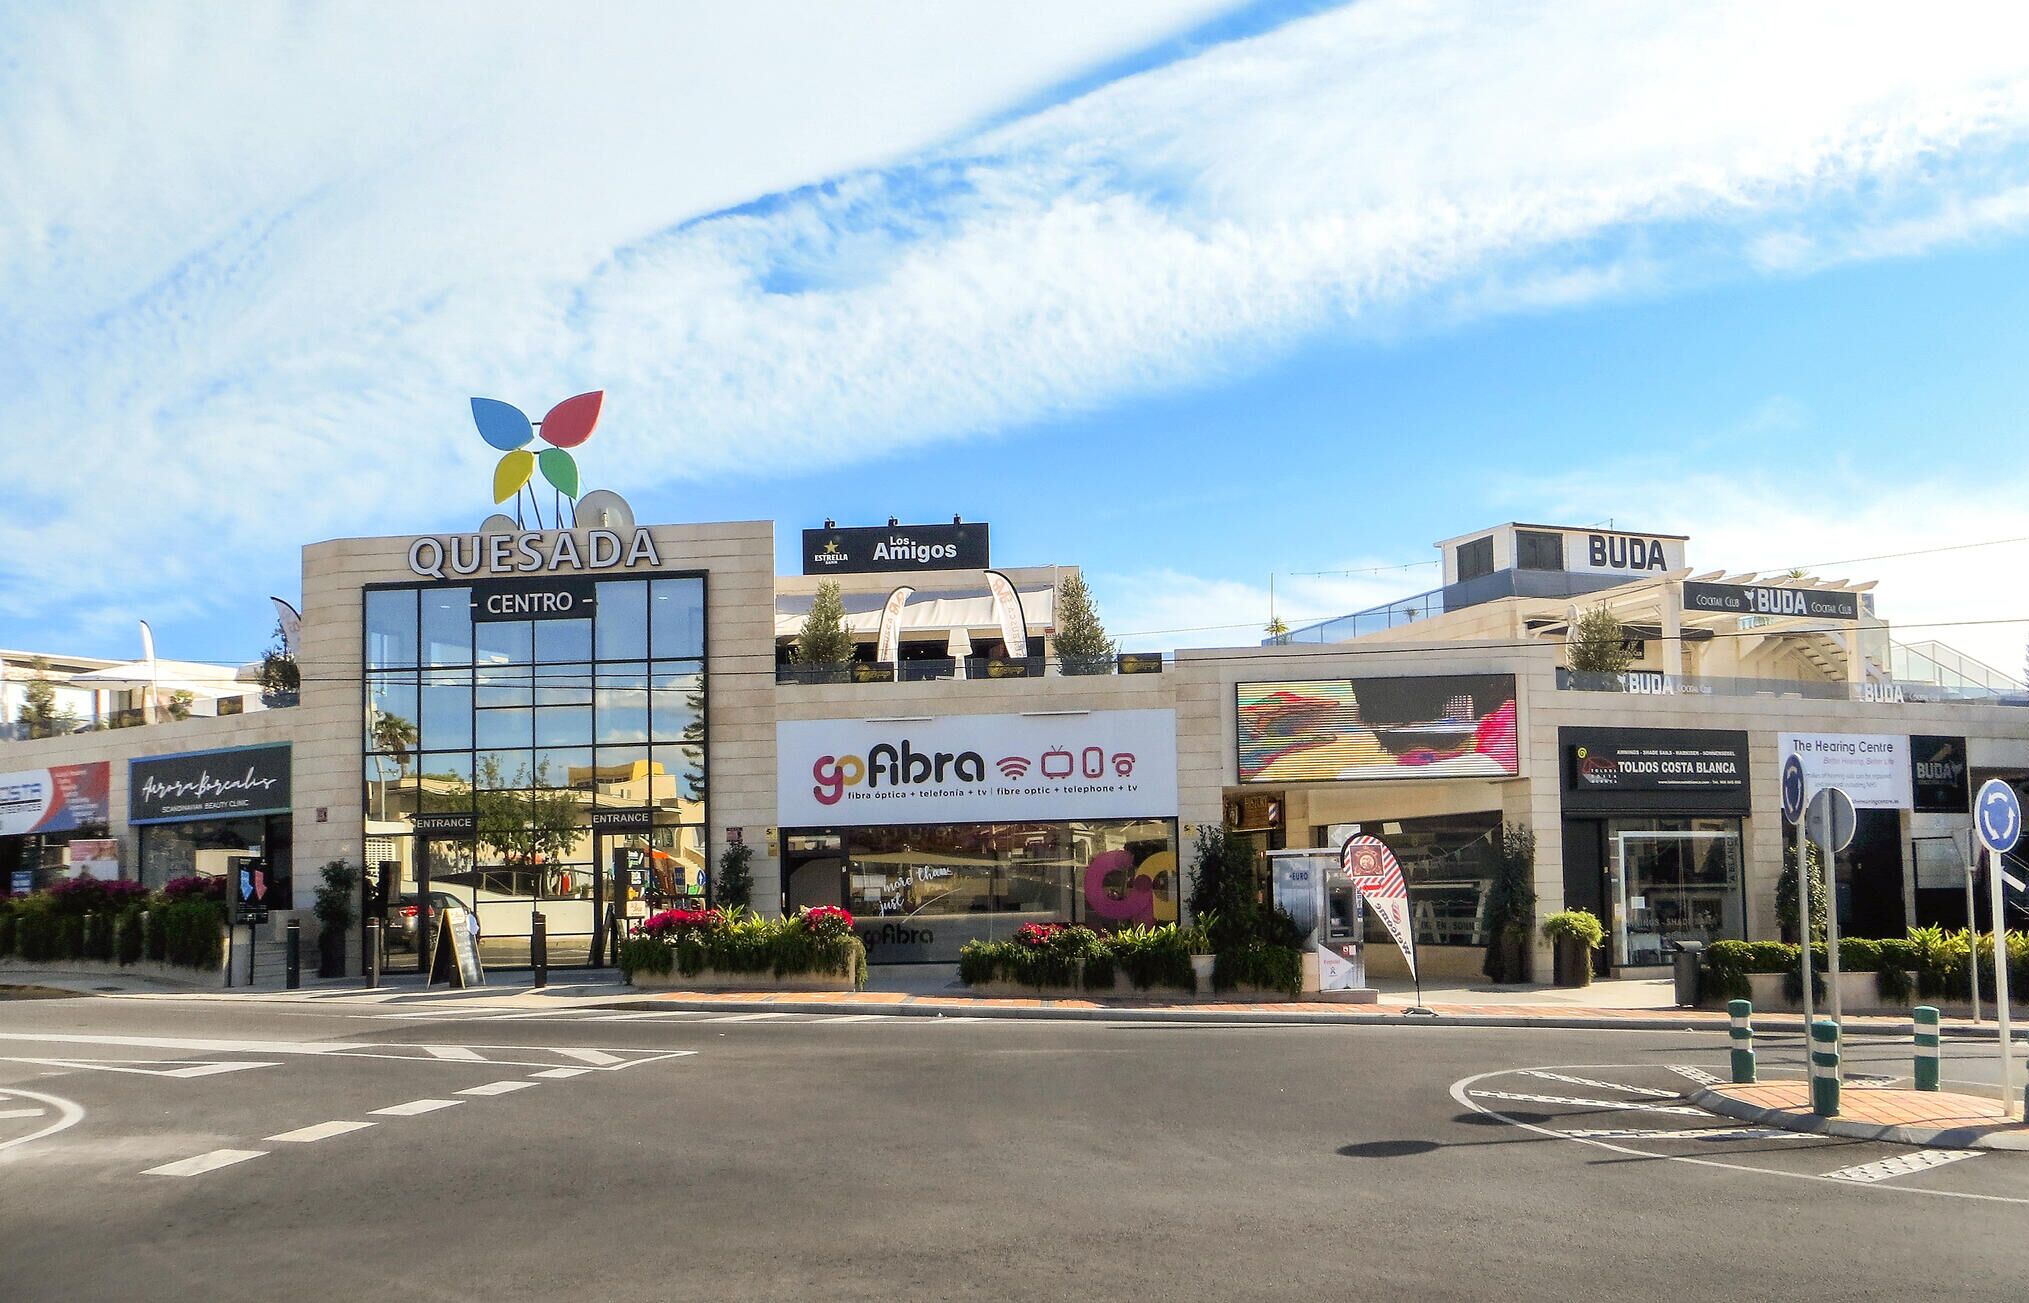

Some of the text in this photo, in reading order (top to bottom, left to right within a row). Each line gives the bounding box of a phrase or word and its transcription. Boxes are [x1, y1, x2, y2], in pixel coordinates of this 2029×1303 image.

[872, 540, 957, 563] Amigos
[889, 536, 910, 546] Los
[408, 527, 661, 579] QUESADA
[814, 553, 849, 562] ESTRELLA
[1588, 534, 1668, 572] BUDA
[487, 591, 573, 614] CENTRO
[1757, 588, 1808, 615] BUDA
[1629, 673, 1675, 695] BUDA
[1864, 682, 1905, 704] BUDA
[1793, 739, 1894, 755] The Hearing Centre
[812, 739, 985, 806] gofibra
[1617, 761, 1737, 774] TOLDOS COSTA BLANCA
[1916, 762, 1953, 779] BUDA
[848, 791, 871, 800] fibra
[875, 790, 907, 800] óptica
[919, 788, 964, 798] telefonía
[977, 788, 987, 796] tv
[996, 787, 1021, 795] fibre
[1024, 786, 1051, 795] optic
[1063, 785, 1115, 794] telephone
[1128, 784, 1138, 792] tv
[204, 801, 229, 810] BEAUTY
[229, 799, 249, 808] CLINIC
[416, 818, 472, 828] ENTRANCE
[593, 813, 649, 823] ENTRANCE
[883, 865, 953, 893] more than
[879, 892, 905, 918] just
